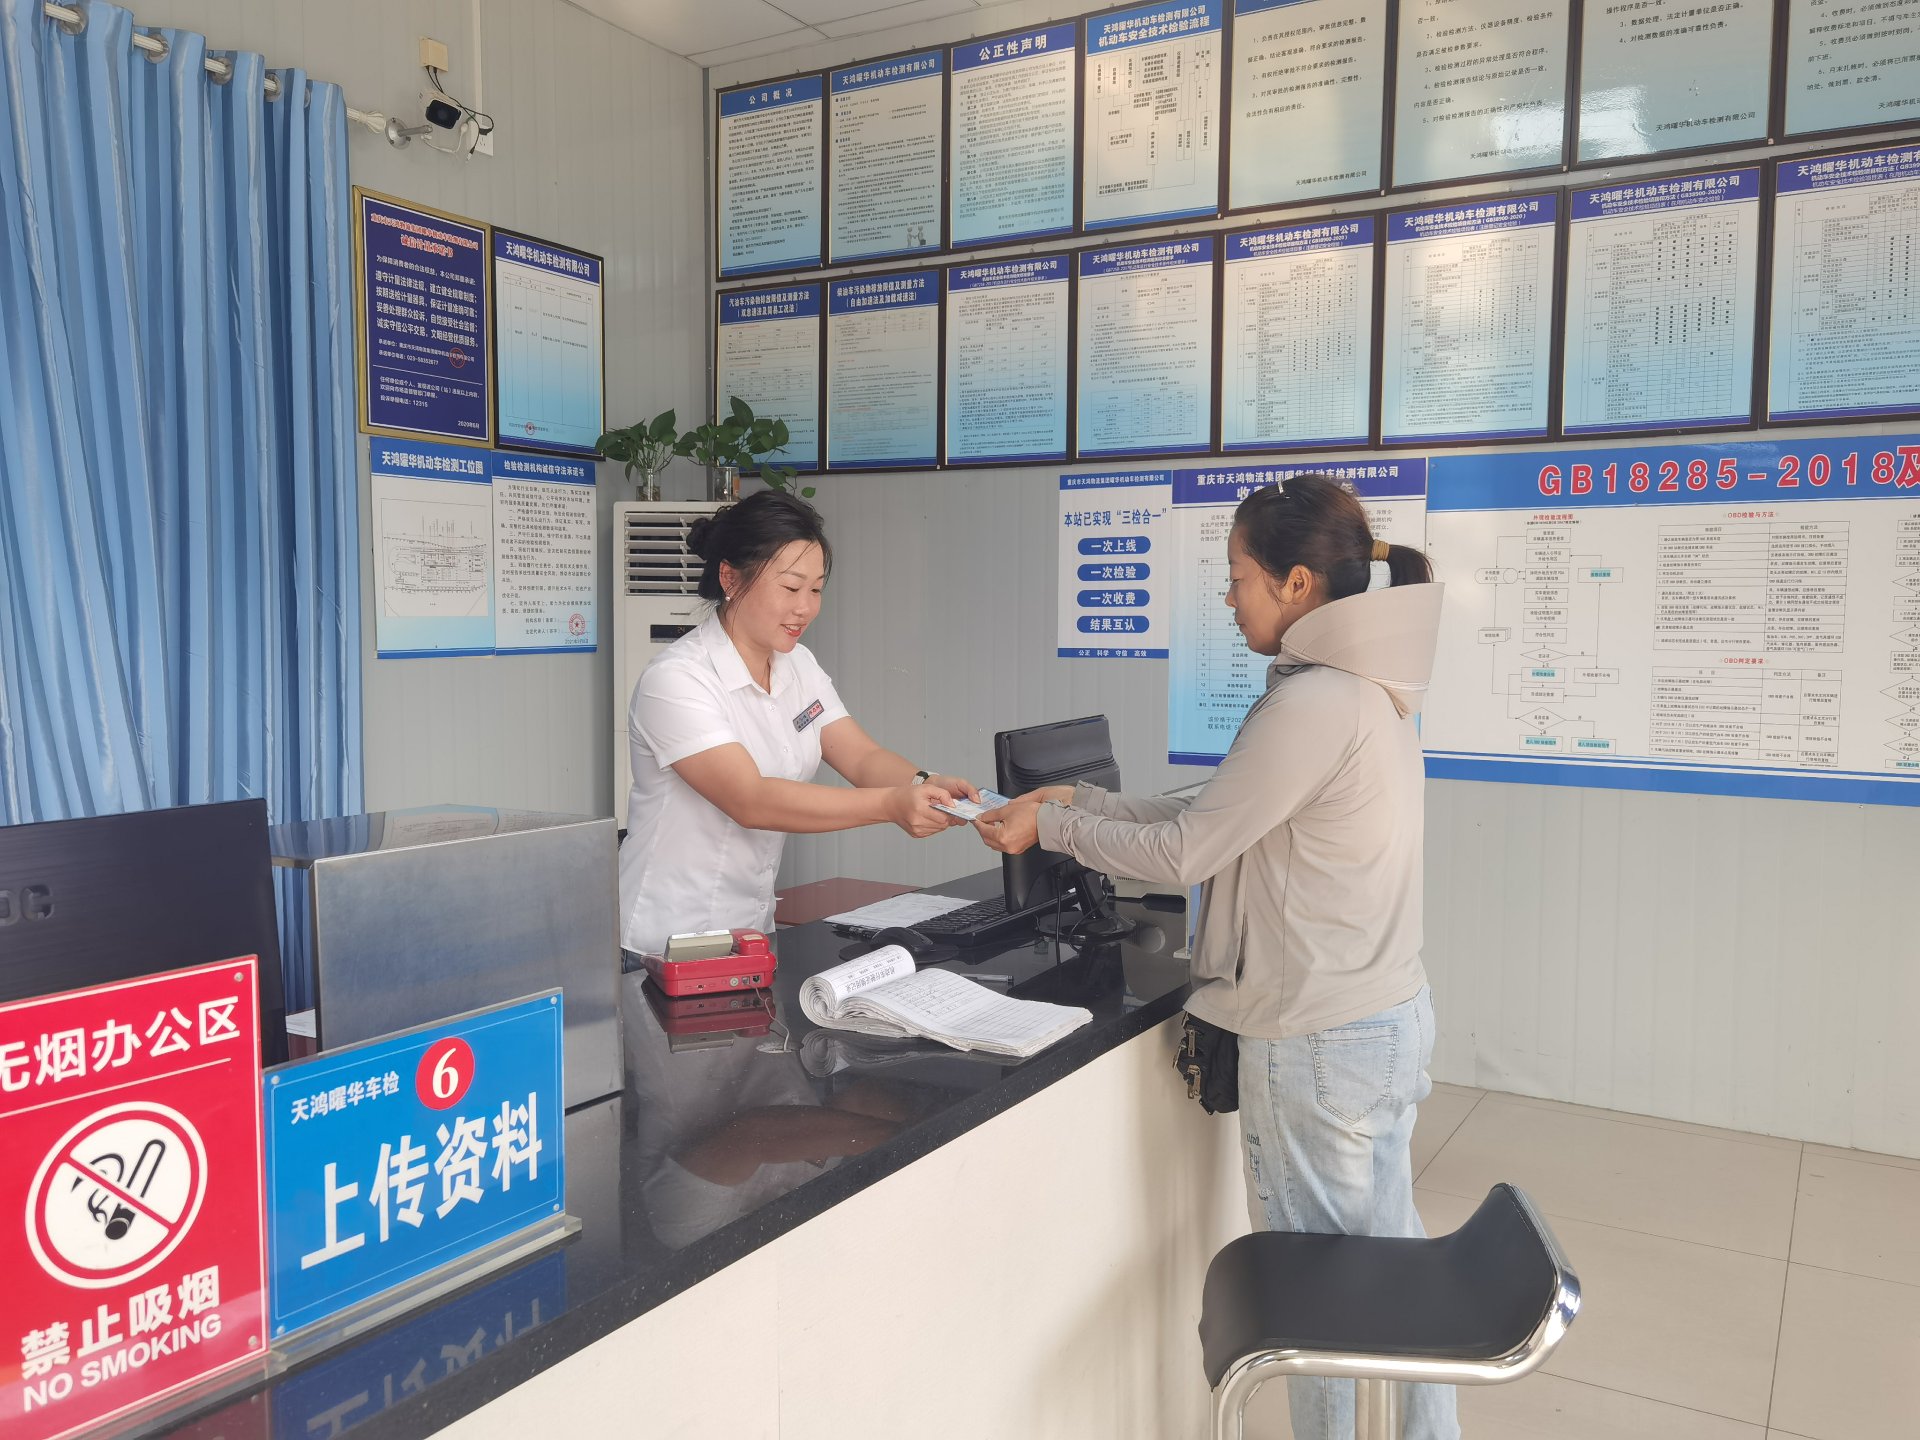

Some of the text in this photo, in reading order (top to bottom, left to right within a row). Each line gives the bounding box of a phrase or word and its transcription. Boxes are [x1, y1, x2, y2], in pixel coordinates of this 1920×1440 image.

[1098, 17, 1210, 48] 机动车安全技术检验流程
[979, 33, 1048, 62] 公正性声明
[748, 87, 793, 105] 公司概况
[1589, 174, 1741, 204] 天鸿曜华机动车检测有限公司
[1404, 200, 1539, 229] 天鸿曜华机动车检测有限公司
[1240, 223, 1359, 248] 天鸿曜华机动车检测有限公司
[505, 241, 590, 277] 天鸿曜华机动车检测有限公司
[1092, 242, 1200, 264] 天鸿曜华机动车检测有限公司
[960, 260, 1058, 280] 天鸿曜华机动车检测有限公司
[381, 450, 484, 475] 天鸿曜华机动车检测工位图
[1090, 539, 1137, 553] 一次上线
[1090, 566, 1137, 580] 一次检验
[1090, 592, 1136, 605] 一次收费
[1090, 618, 1135, 631] 结果互认
[0, 995, 240, 1093] 无烟办公区
[432, 1047, 459, 1099] 6
[290, 1069, 401, 1126] 天鸿曜华车检
[300, 1091, 543, 1271] 上传资料
[20, 1265, 221, 1380] 禁止吸烟
[23, 1313, 223, 1413] NO SMOKING
